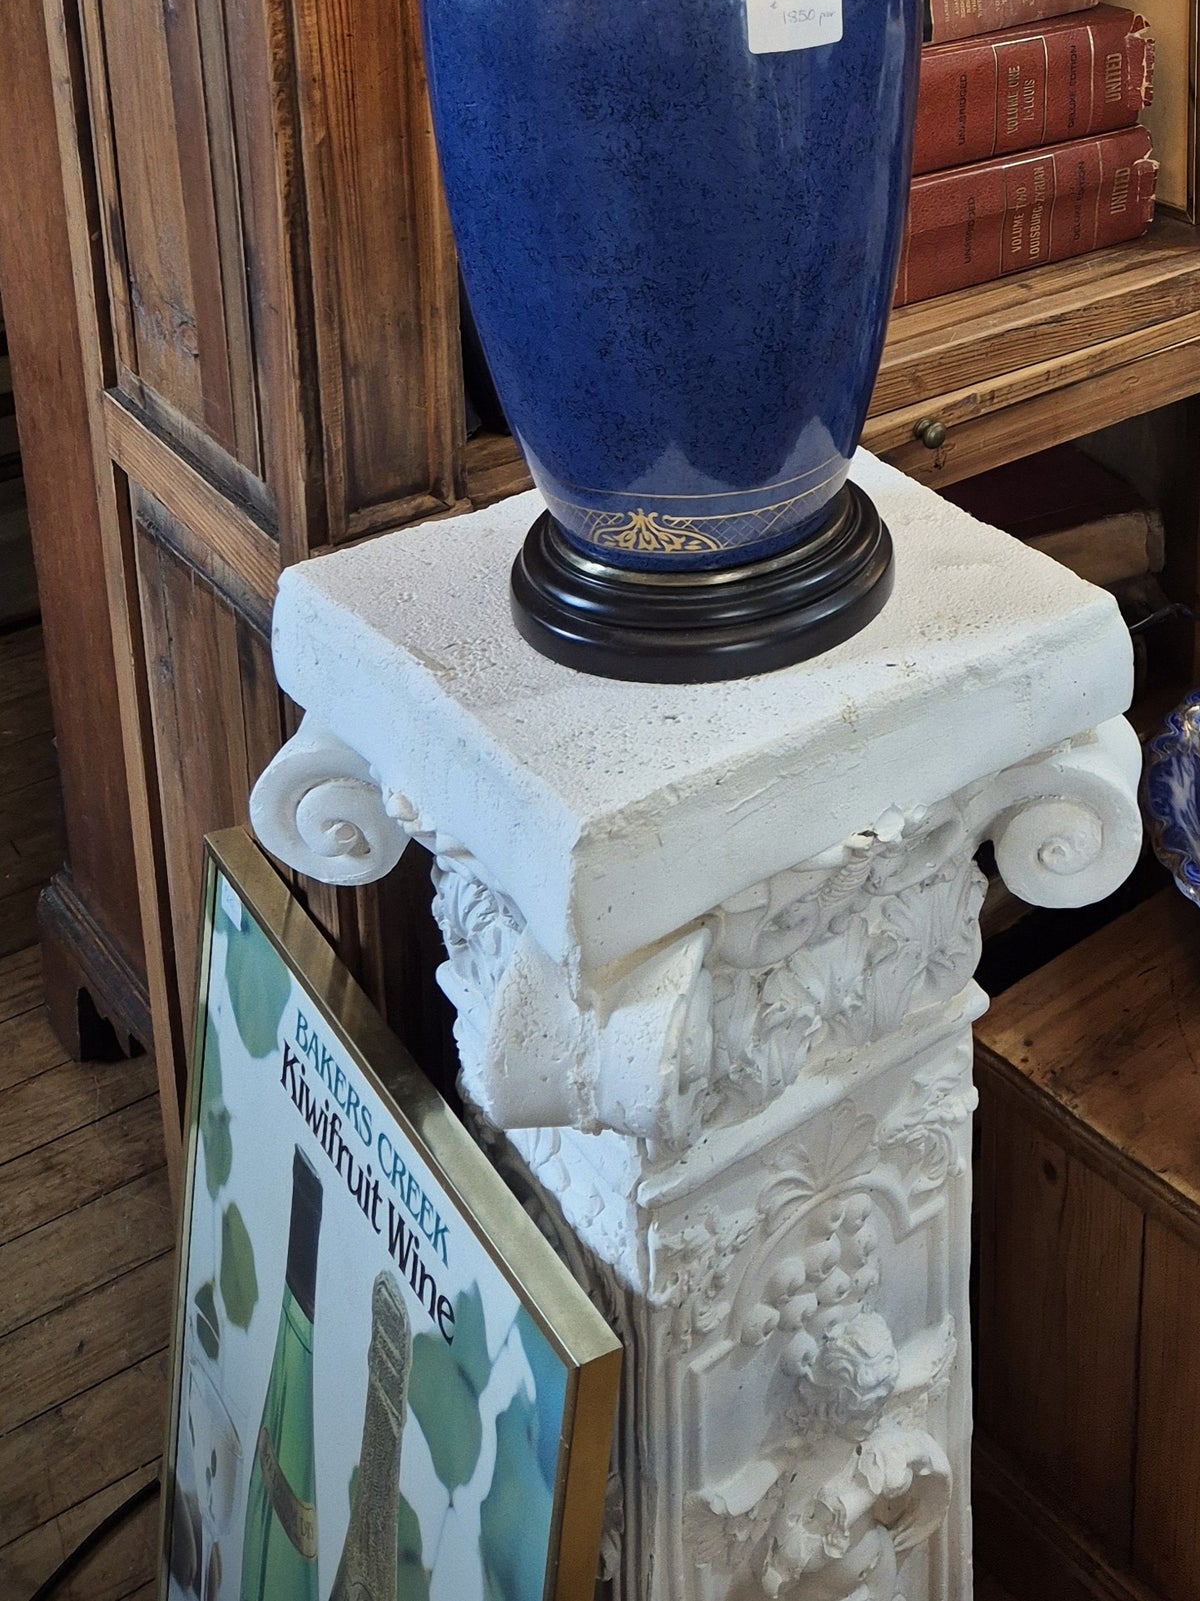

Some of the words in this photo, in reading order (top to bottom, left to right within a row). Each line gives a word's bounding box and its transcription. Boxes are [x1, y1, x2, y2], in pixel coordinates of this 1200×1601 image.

[1008, 65, 1021, 89] ONE
[1069, 45, 1078, 89] EDITION
[1104, 52, 1123, 104] UNITED
[1006, 91, 1019, 135] VOLUME
[1067, 93, 1078, 129] DELUXE
[1015, 186, 1028, 211] TWO
[1110, 166, 1131, 215] UNITED
[1011, 211, 1025, 254] VOLUME
[1028, 165, 1046, 262] LOUISBURG-ZYRIAN
[294, 1006, 374, 1147] BAKERS
[377, 1132, 451, 1270] CREEK
[279, 1037, 383, 1236] Kiwifruit
[387, 1196, 456, 1347] Wine
